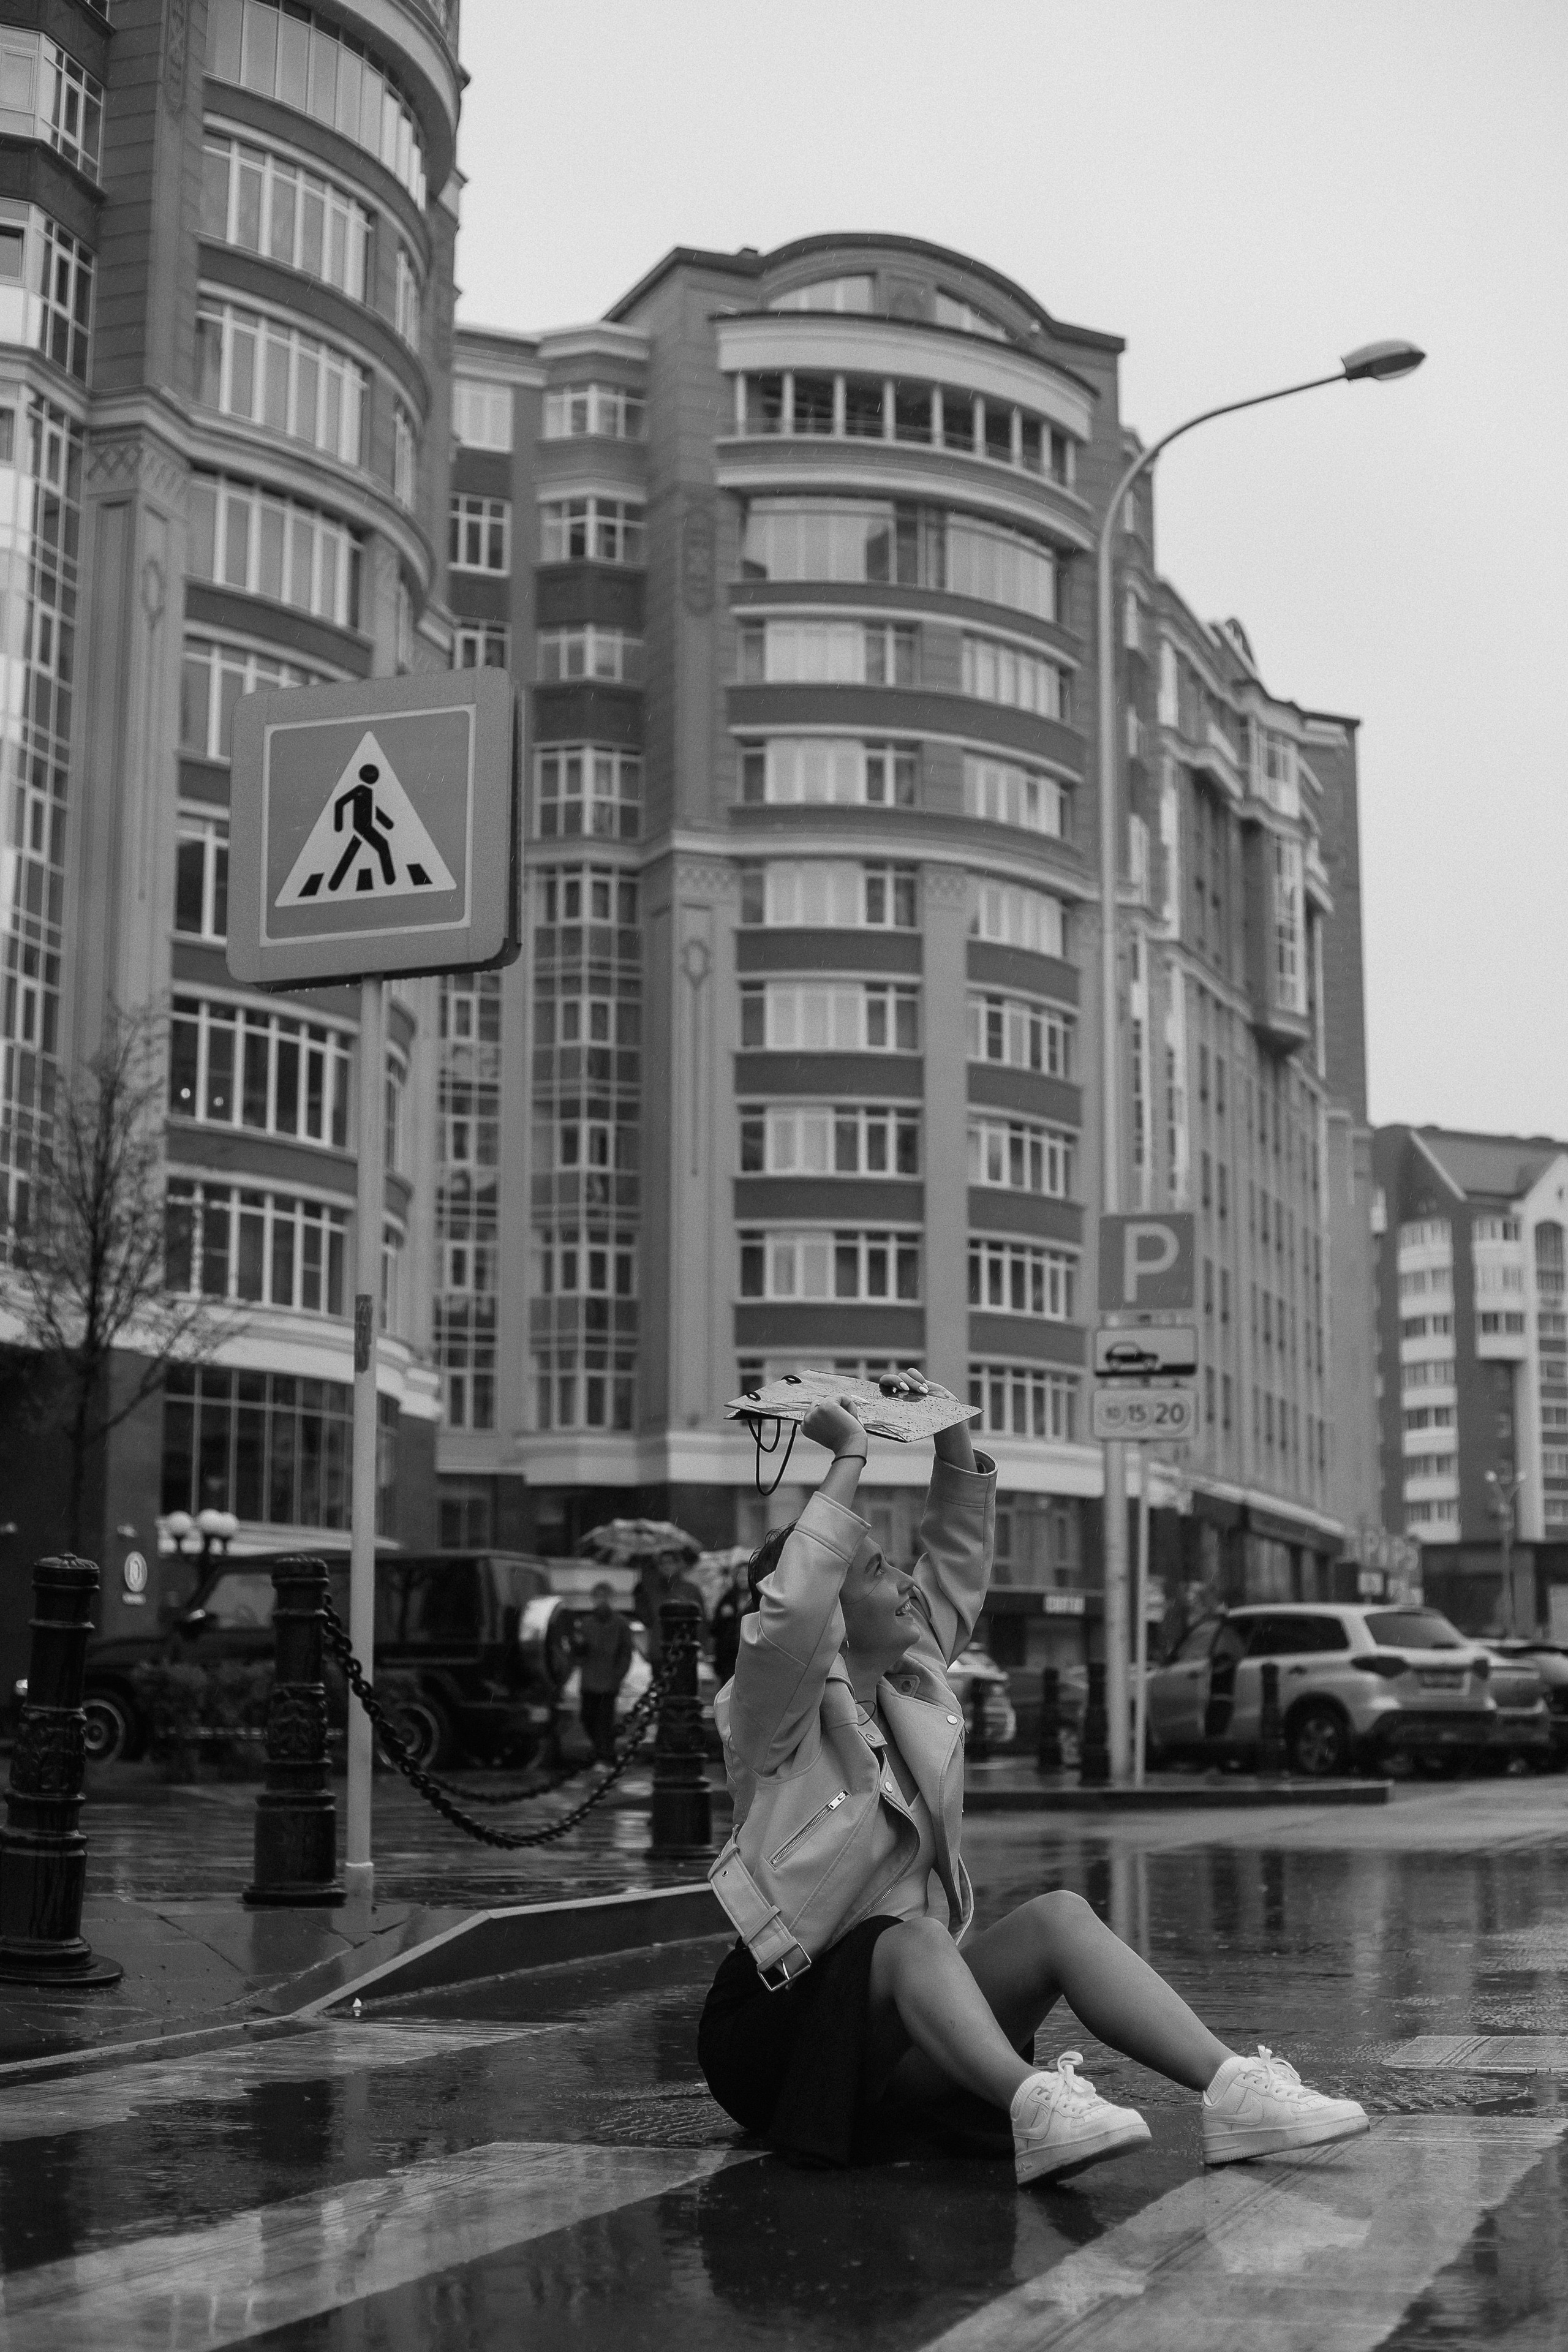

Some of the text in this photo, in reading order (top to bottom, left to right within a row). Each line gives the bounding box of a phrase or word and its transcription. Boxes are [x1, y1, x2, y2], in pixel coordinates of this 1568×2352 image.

[1124, 1223, 1180, 1302] P
[1128, 1404, 1146, 1422] 15
[1155, 1401, 1185, 1424] 20
